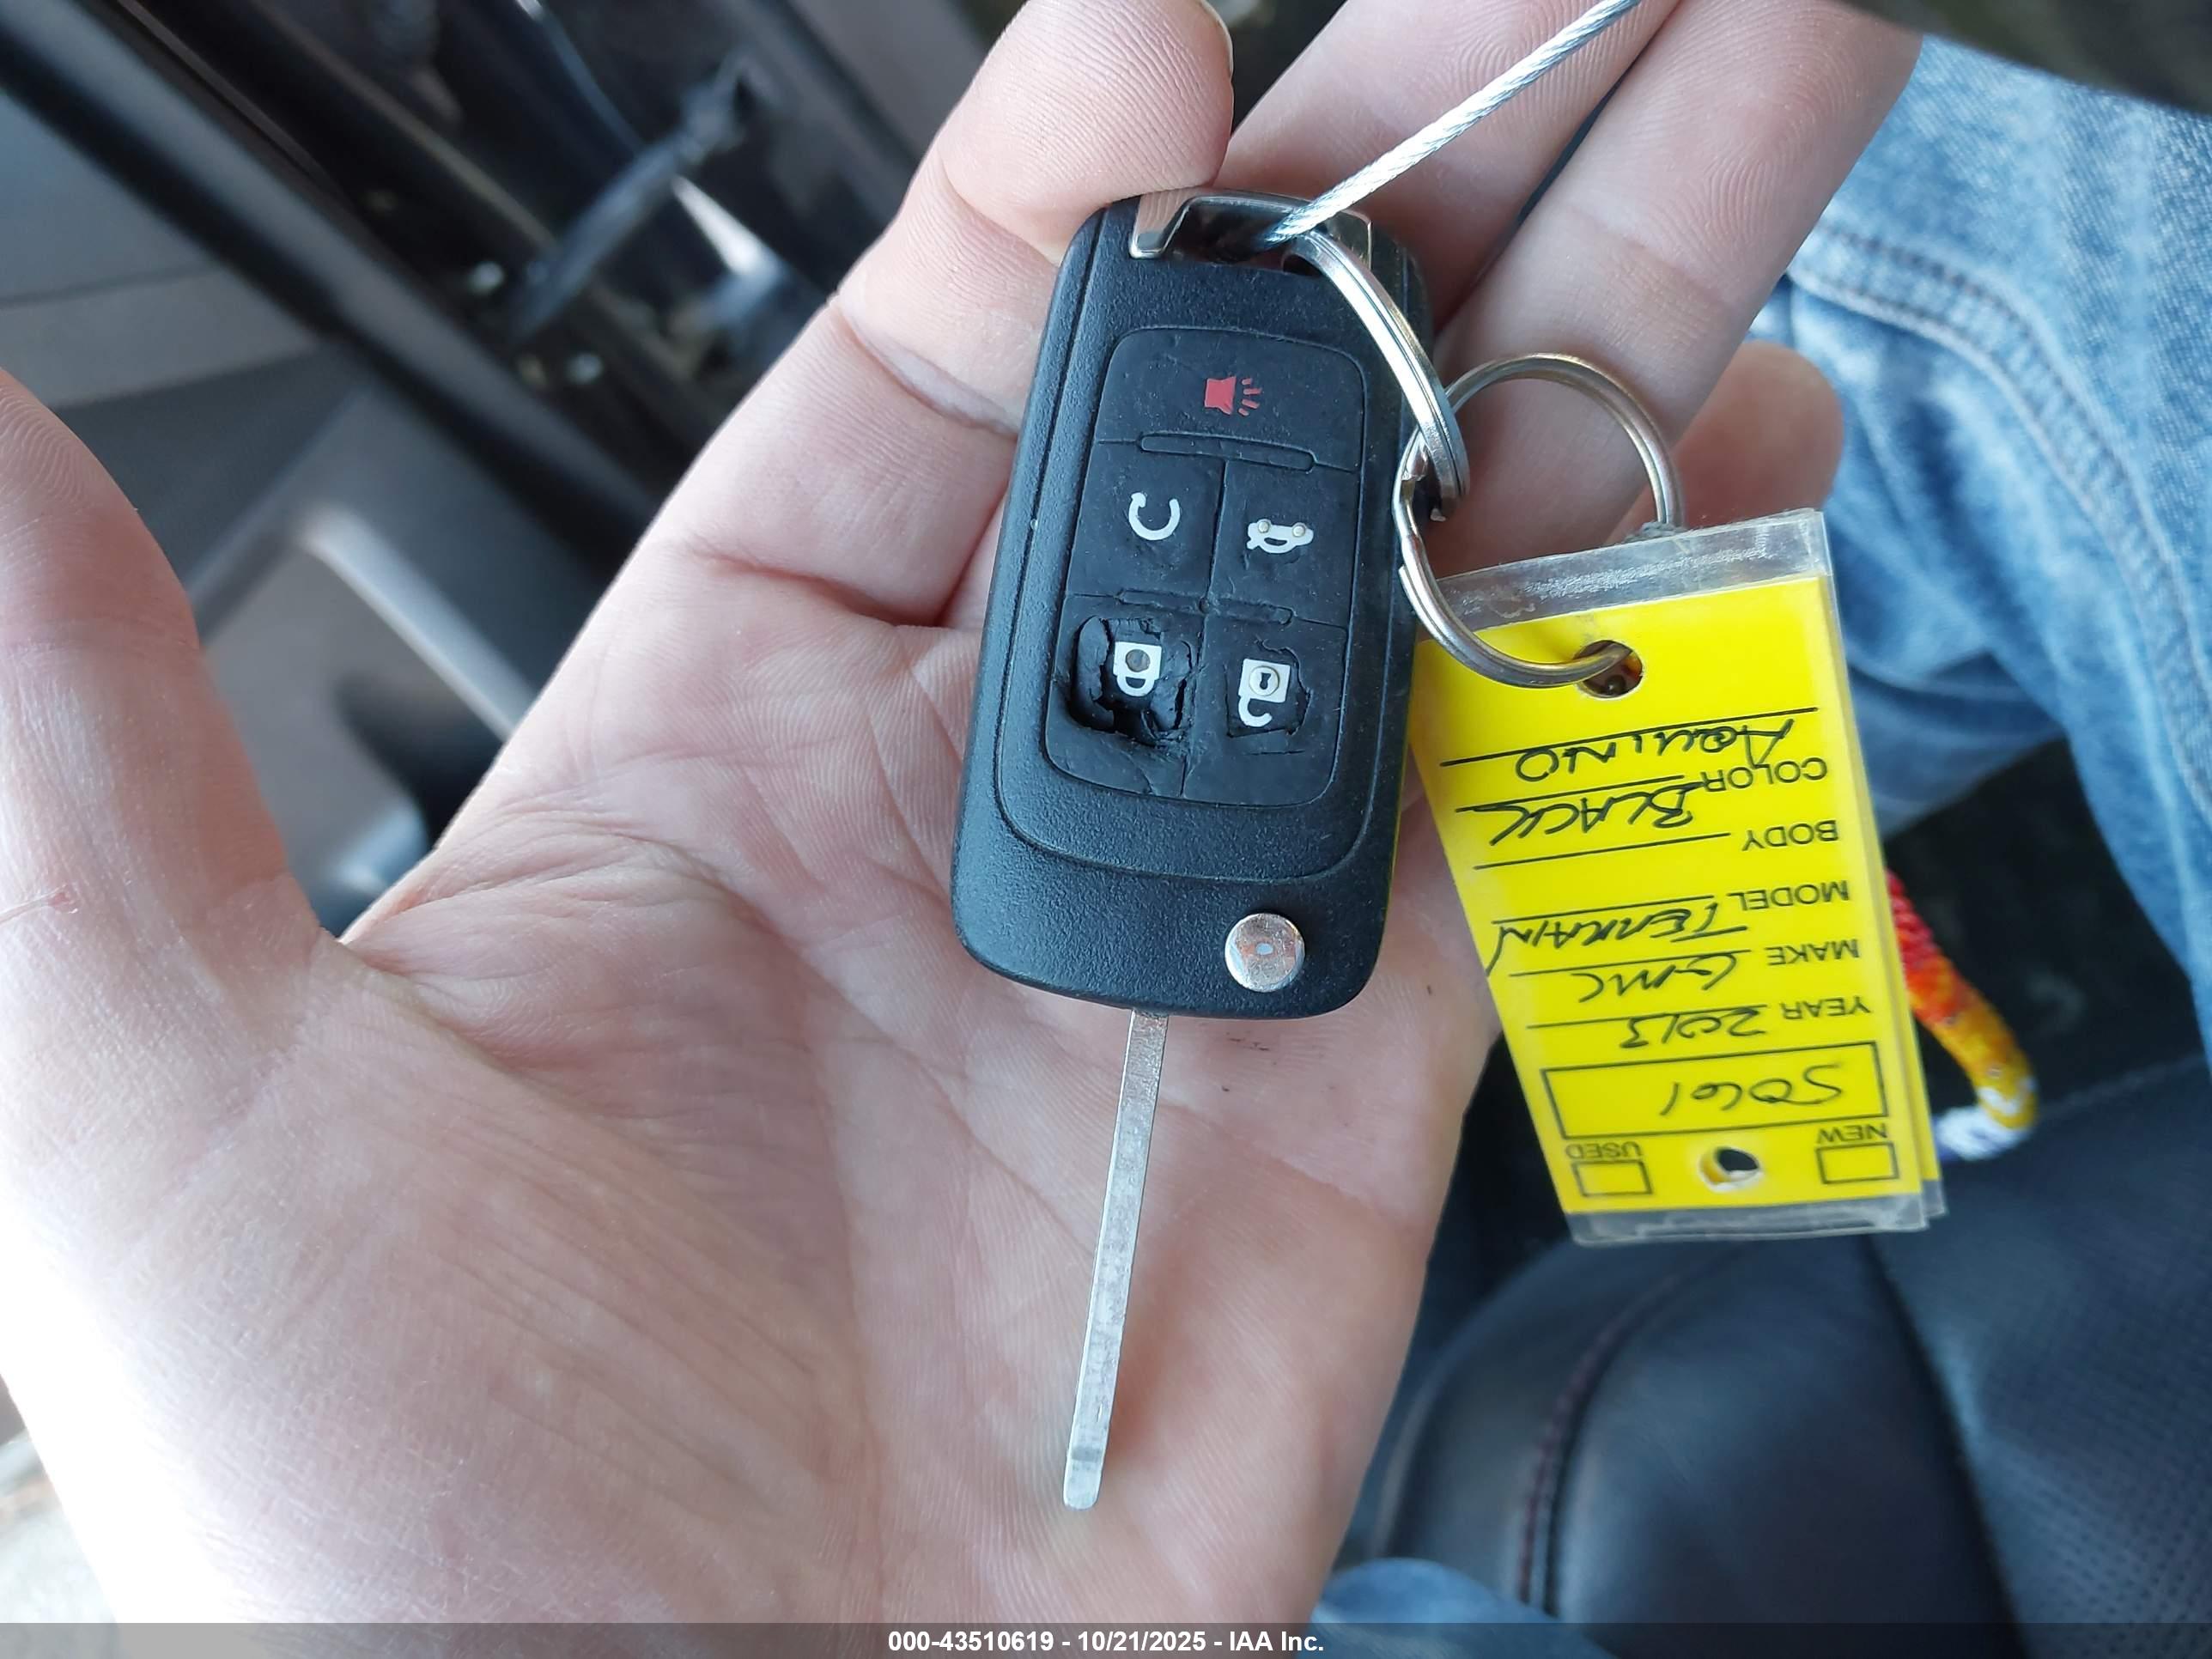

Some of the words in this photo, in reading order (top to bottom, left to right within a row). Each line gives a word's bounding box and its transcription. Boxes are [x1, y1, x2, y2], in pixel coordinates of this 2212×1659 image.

[1516, 719, 1793, 781] AQUINO
[1700, 757, 1828, 792] COLOR
[1463, 782, 1703, 846] BLACK
[1741, 820, 1838, 851] BODY
[1727, 879, 1850, 910] MODEL
[1486, 902, 1747, 978] TERRAIN
[1767, 939, 1859, 966] MAKE
[1572, 951, 1738, 1003] GMC
[1781, 996, 1871, 1020] YEAR
[1620, 1006, 1766, 1048] 2013
[1817, 1123, 1887, 1144] NEW
[1566, 1141, 1642, 1160] USED
